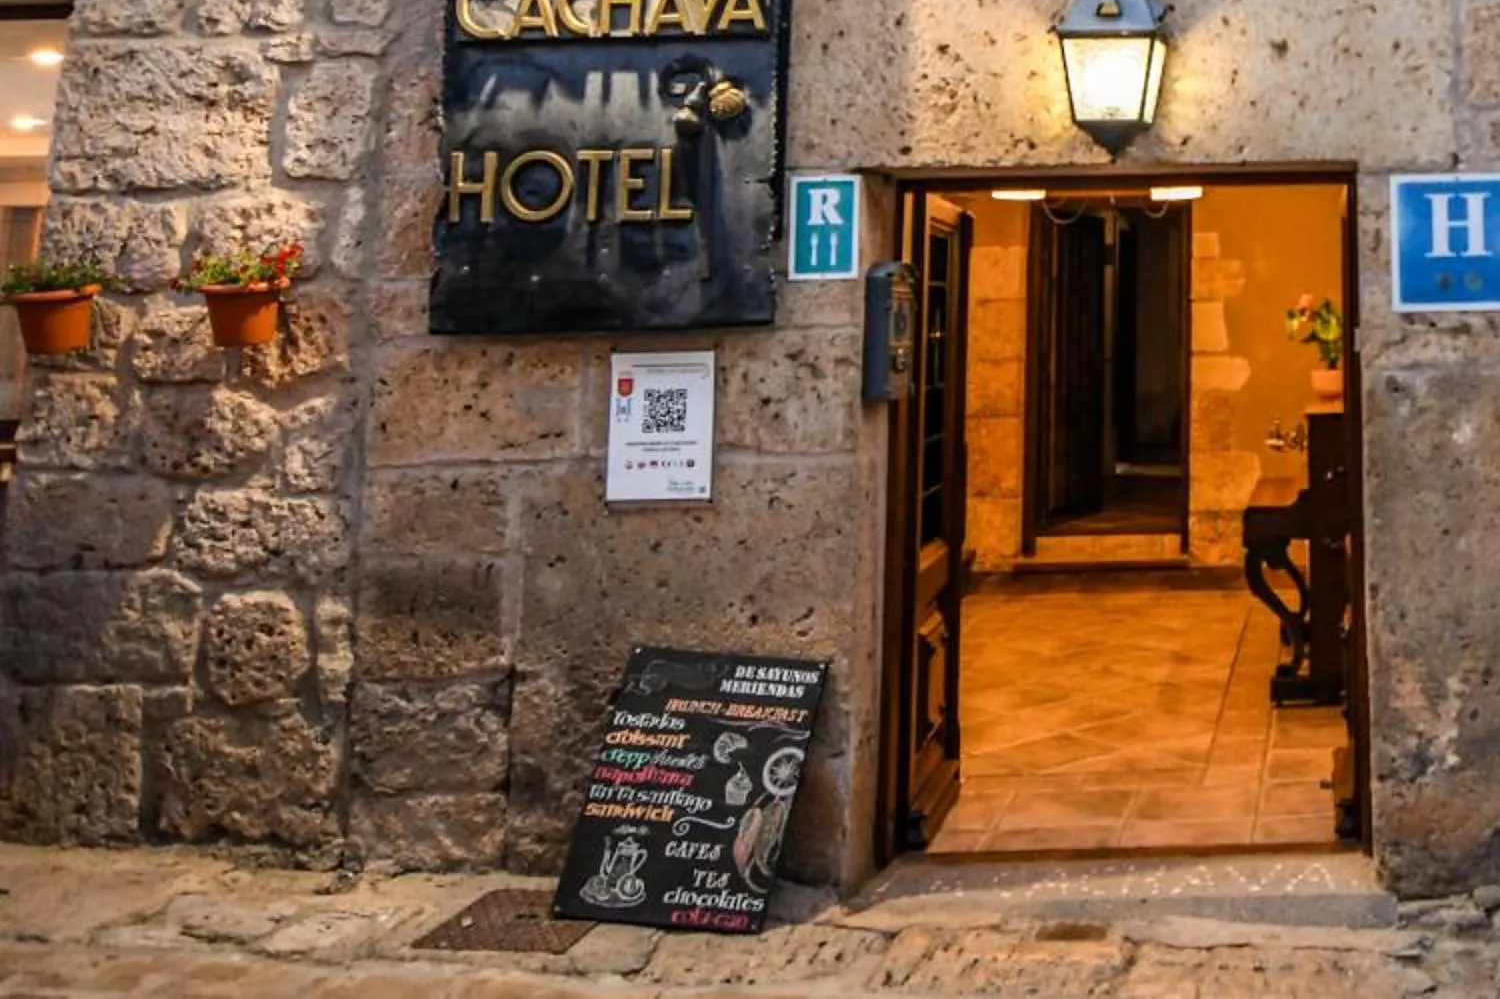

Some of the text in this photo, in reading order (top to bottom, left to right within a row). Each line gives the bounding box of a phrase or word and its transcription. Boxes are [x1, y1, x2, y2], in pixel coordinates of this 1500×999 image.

[448, 147, 693, 223] HOTEL
[806, 188, 844, 226] R
[1423, 191, 1494, 258] H
[734, 664, 821, 684] DESAYUNOS
[719, 678, 807, 698] MERIENDAS
[583, 802, 675, 821] sandwich
[665, 840, 725, 861] CAFES
[693, 868, 732, 889] TES
[663, 886, 765, 912] chocolates
